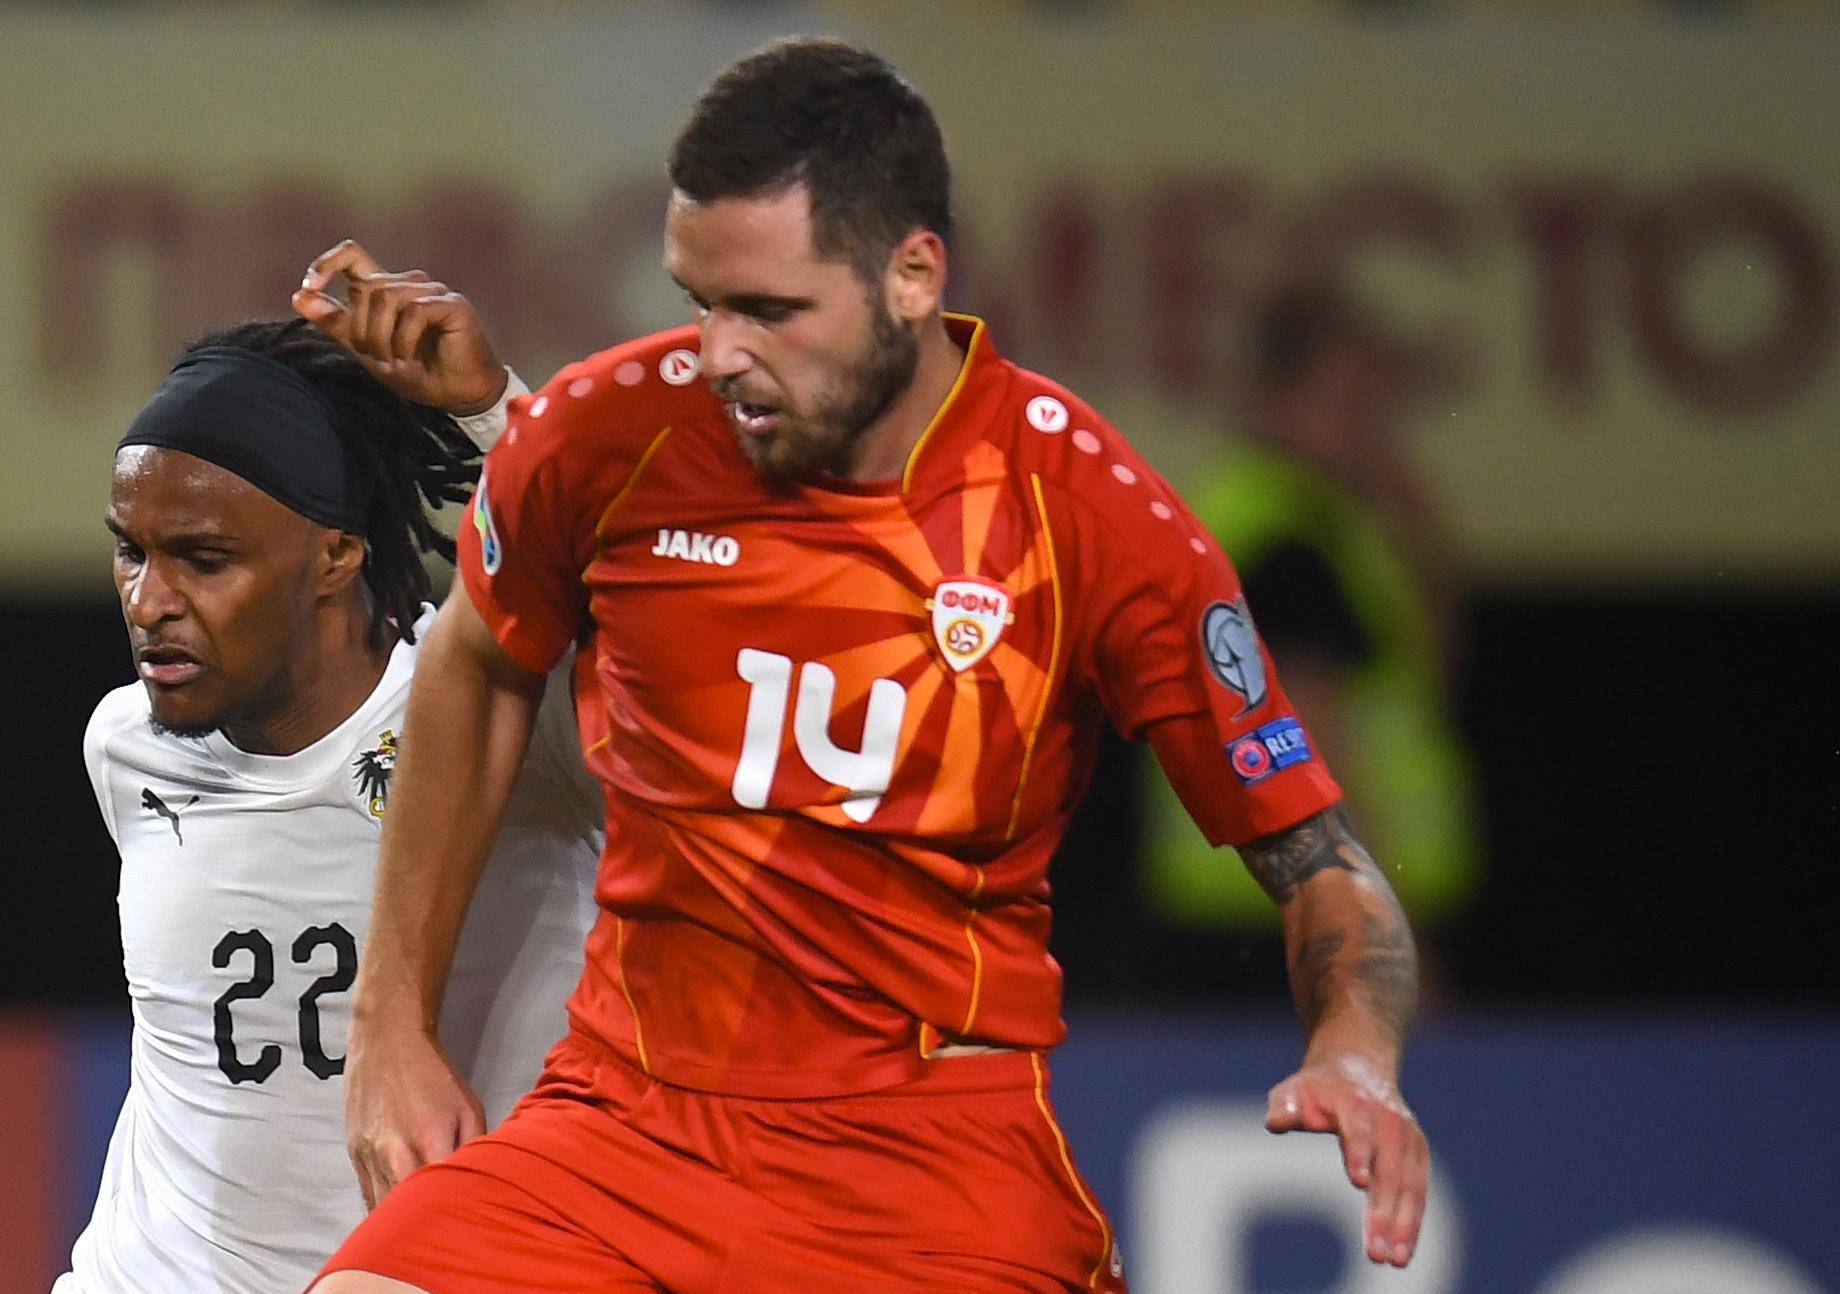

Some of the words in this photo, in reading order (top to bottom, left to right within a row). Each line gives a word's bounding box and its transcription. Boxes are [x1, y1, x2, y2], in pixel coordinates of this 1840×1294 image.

[652, 527, 740, 567] JAKO
[731, 647, 908, 823] 14
[211, 921, 359, 1085] 22
